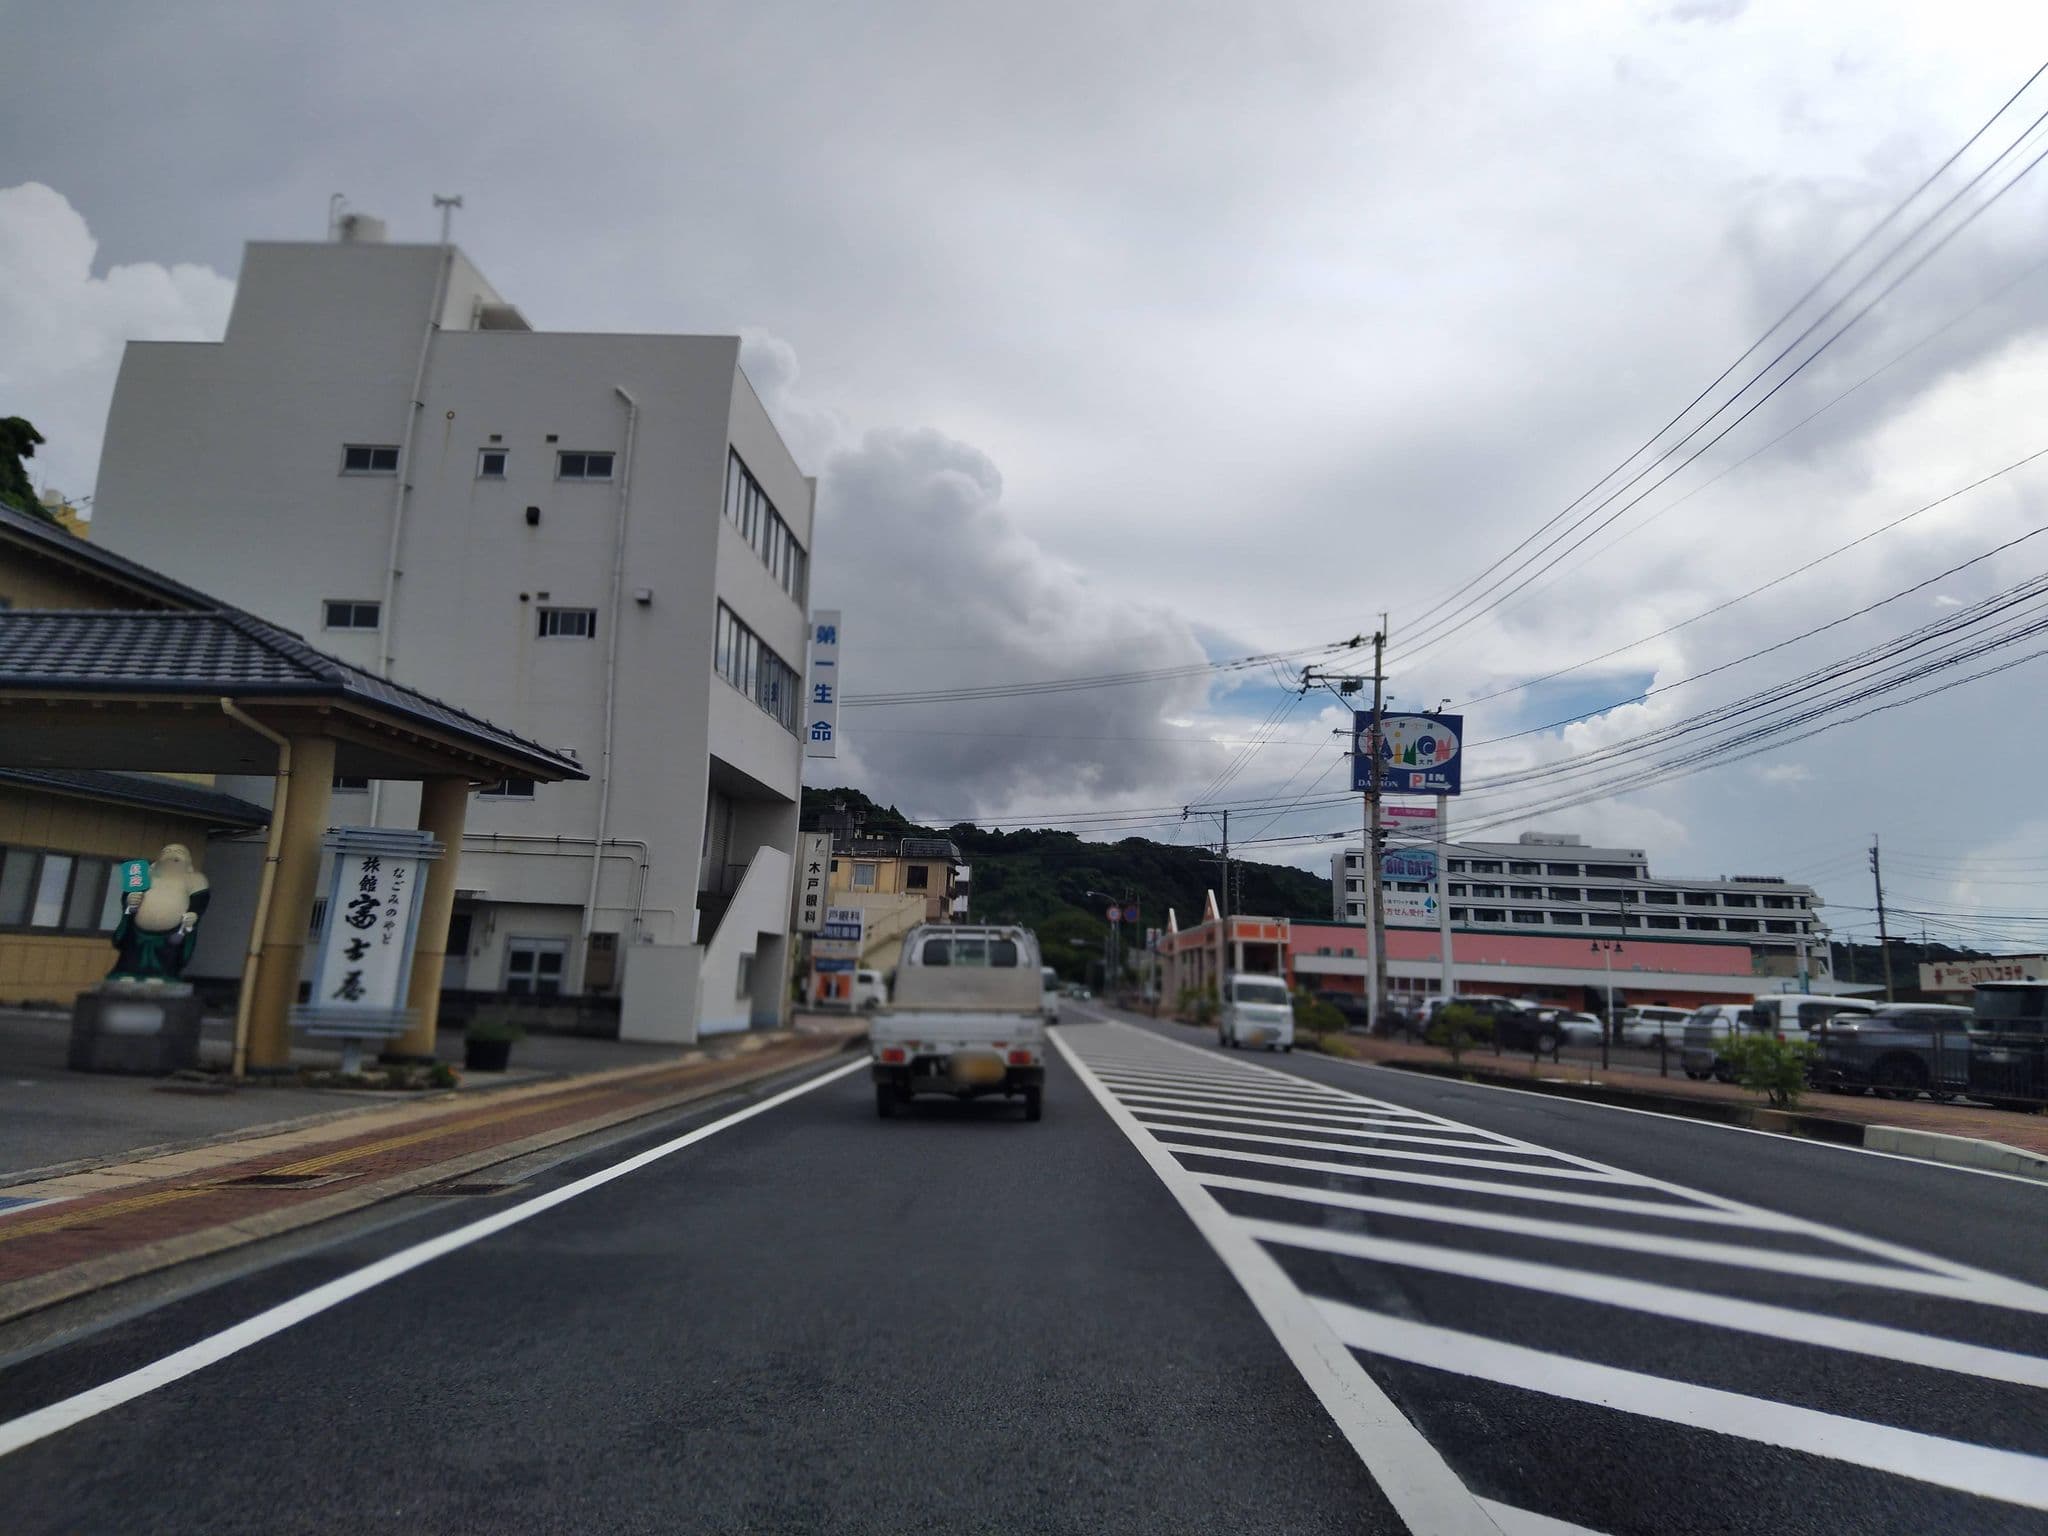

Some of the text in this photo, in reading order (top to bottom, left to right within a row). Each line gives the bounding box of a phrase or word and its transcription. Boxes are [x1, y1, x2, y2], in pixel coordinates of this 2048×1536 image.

[811, 624, 836, 741] 第一生命
[1428, 773, 1445, 782] IN
[1386, 859, 1433, 877] BIG GATE
[804, 861, 821, 923] 木戸眼科
[382, 867, 405, 945] なごみのやど
[827, 909, 860, 921] 戸眼科
[1384, 908, 1424, 917] 方せん受付
